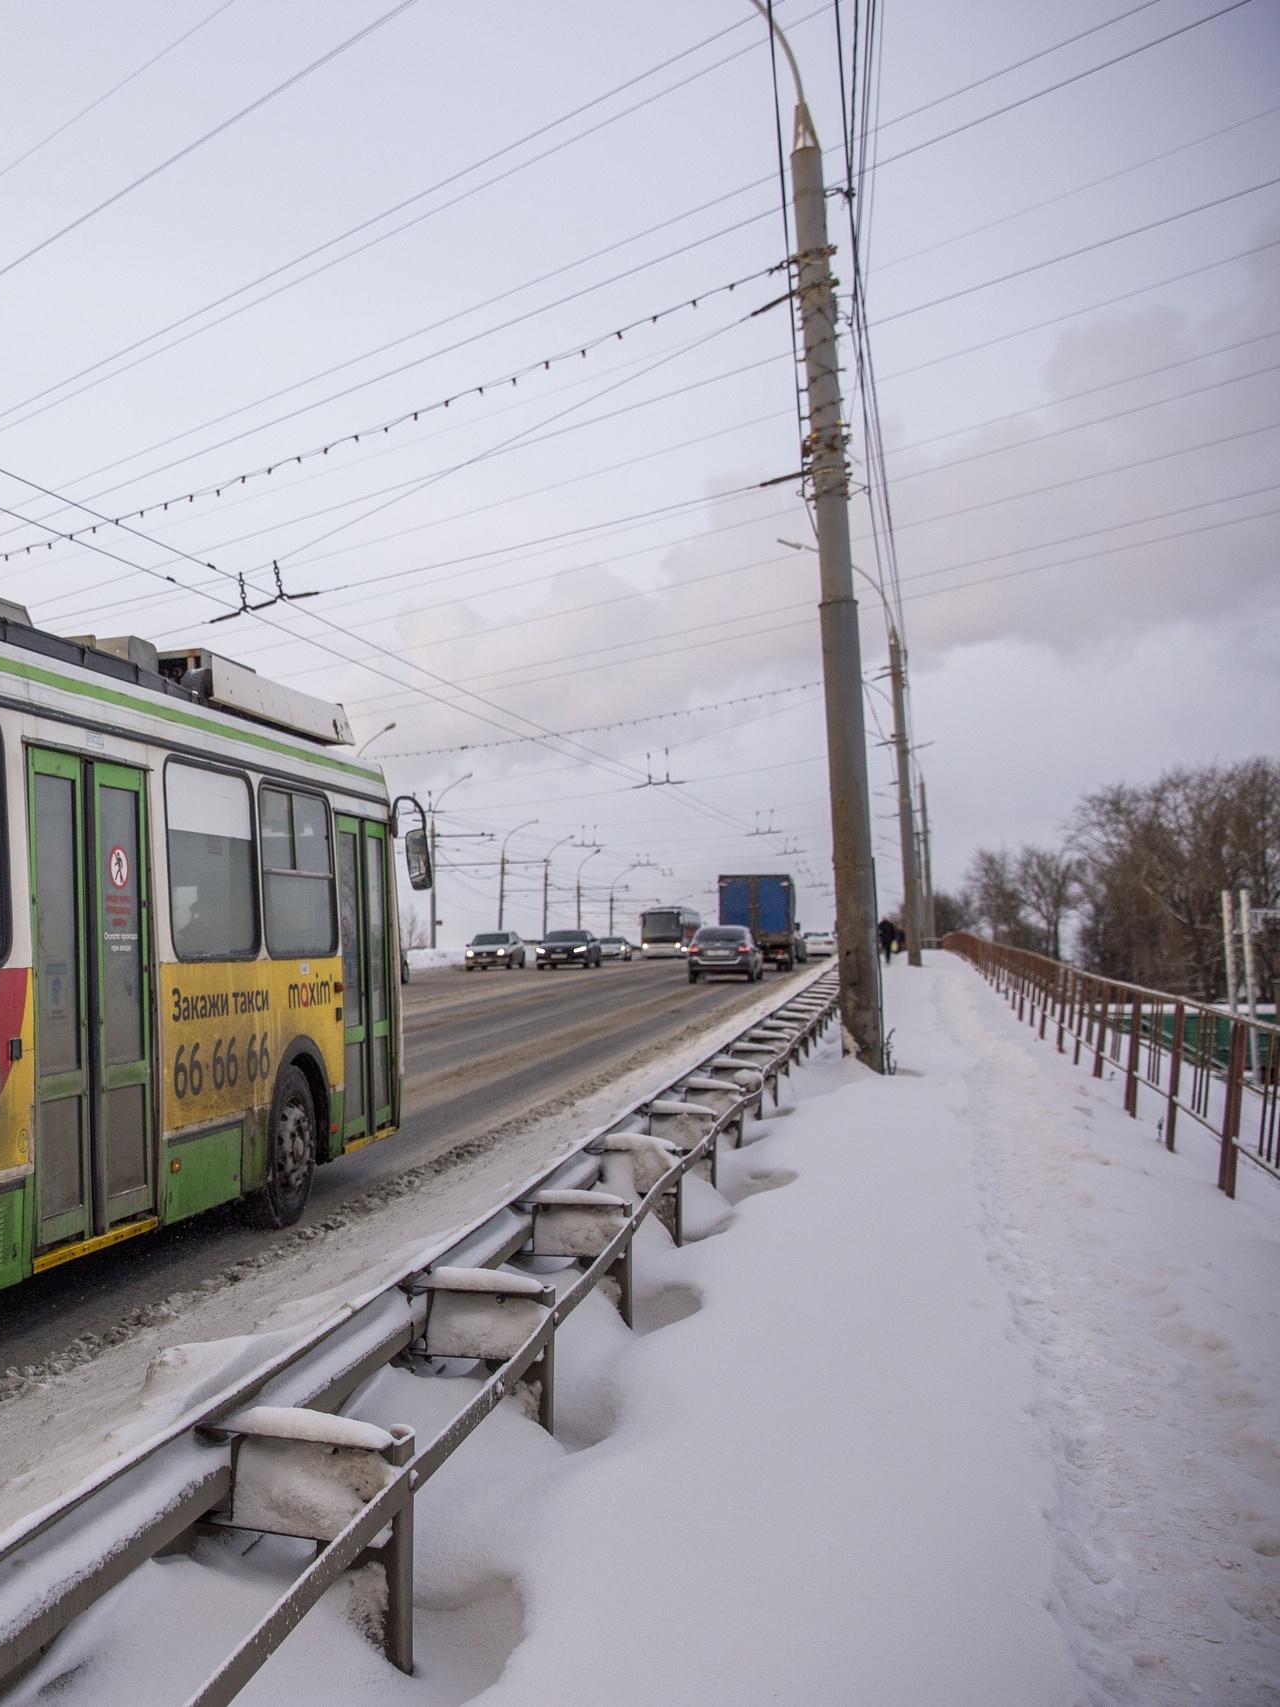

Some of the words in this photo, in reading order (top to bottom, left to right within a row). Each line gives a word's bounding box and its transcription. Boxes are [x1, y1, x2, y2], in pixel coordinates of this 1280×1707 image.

[172, 987, 229, 1023] Закажи
[232, 989, 269, 1015] такси
[174, 1043, 203, 1099] 66
[212, 1038, 238, 1090] 66
[247, 1032, 270, 1082] 66
